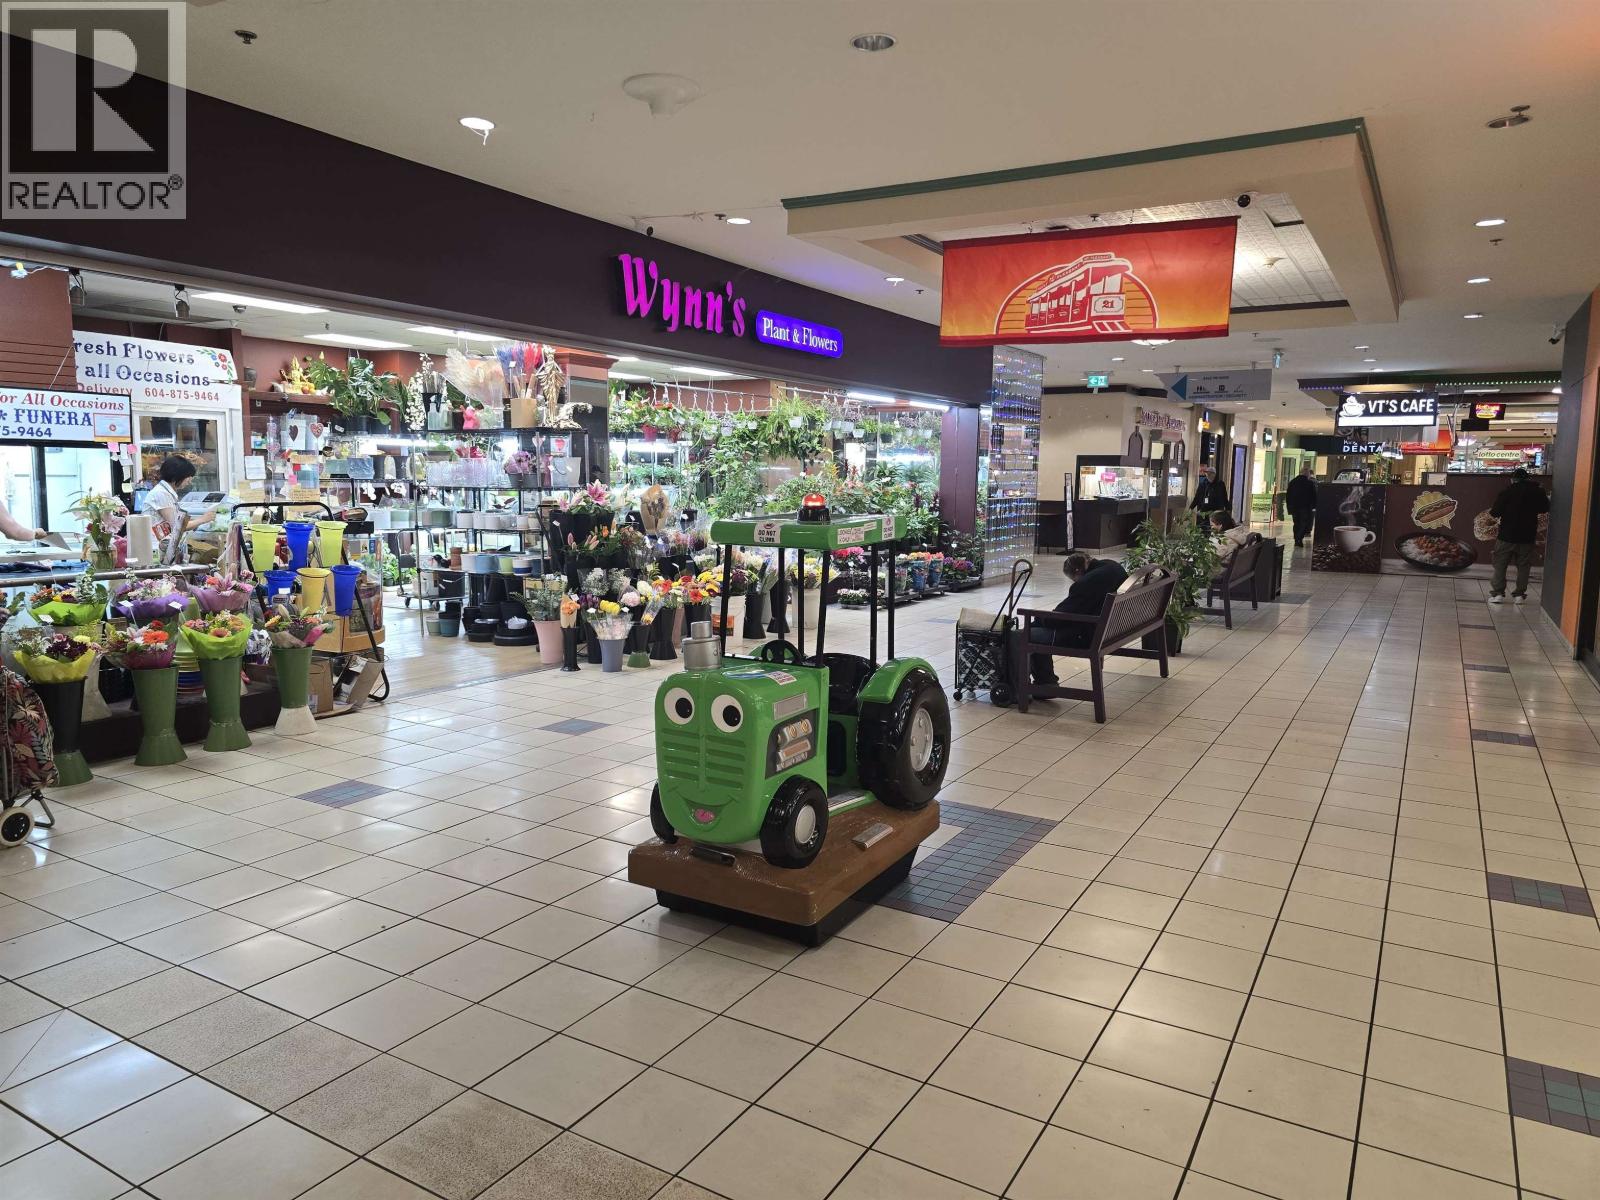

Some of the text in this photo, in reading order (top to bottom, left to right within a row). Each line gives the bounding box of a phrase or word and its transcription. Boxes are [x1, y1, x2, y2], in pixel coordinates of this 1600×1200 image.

[617, 252, 747, 338] Wynn's
[1102, 300, 1114, 309] 21
[762, 317, 838, 352] Plant & Flowers
[73, 341, 195, 365] resh Flowers
[84, 363, 210, 386] all Occasions
[0, 392, 124, 411] or All Occasions
[144, 387, 219, 402] 604-875-9464
[1367, 398, 1435, 413] VT'S CAFE
[14, 408, 93, 427] FUNERA
[0, 425, 52, 437] 5-9464
[1343, 445, 1384, 453] DENTA
[1478, 450, 1495, 458] lotto
